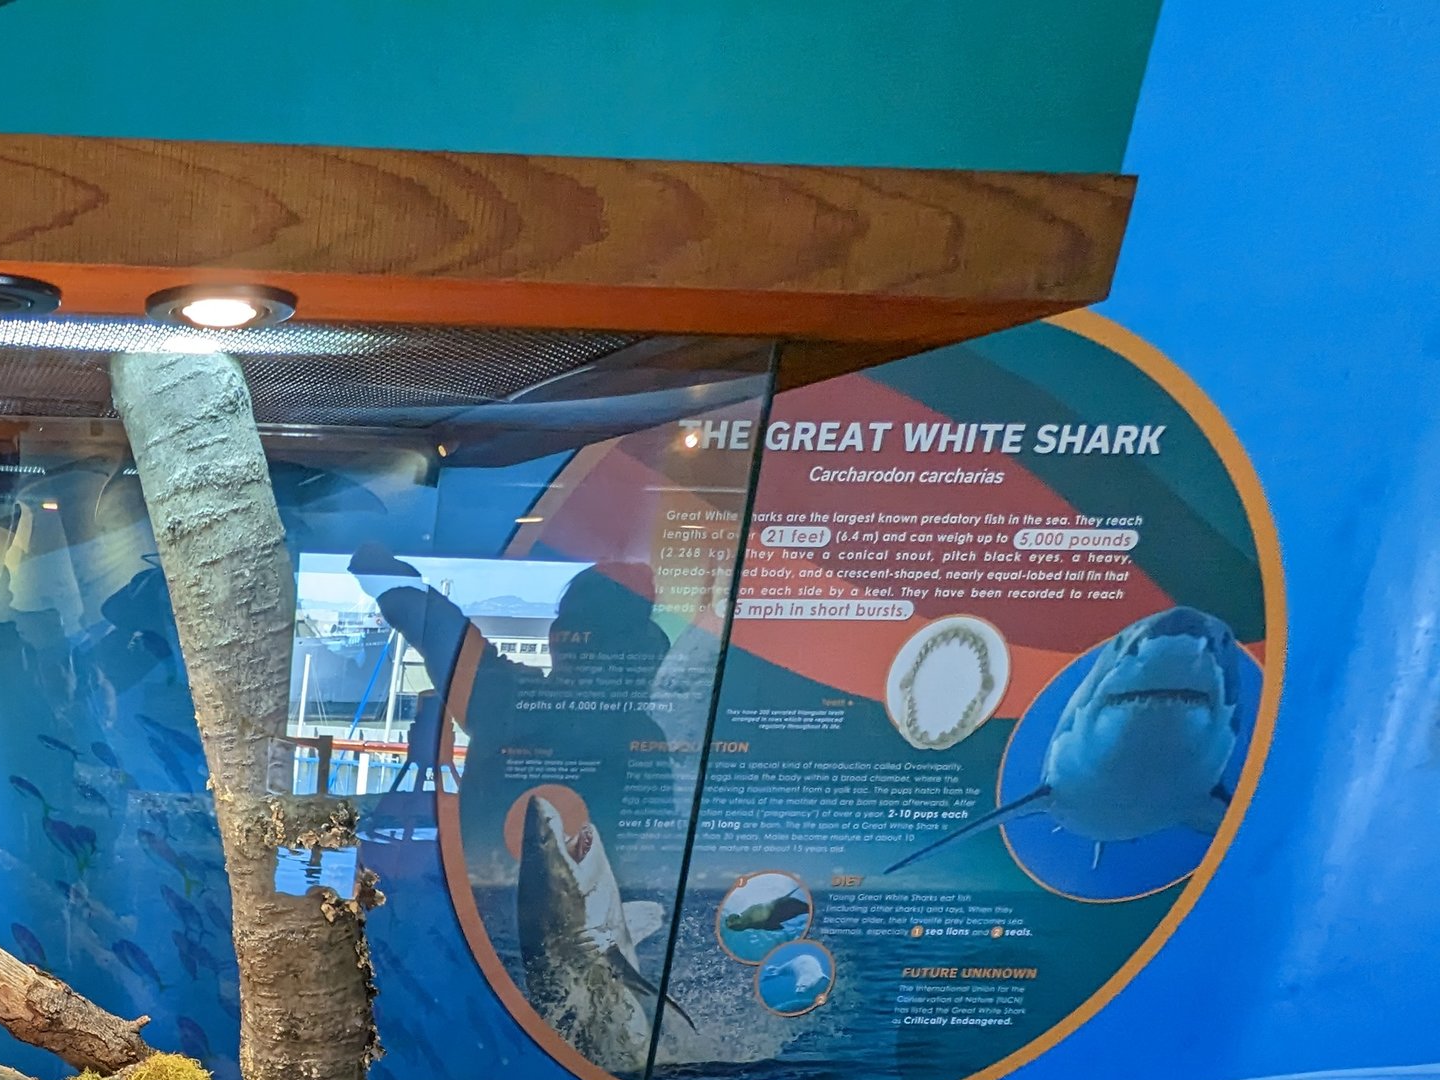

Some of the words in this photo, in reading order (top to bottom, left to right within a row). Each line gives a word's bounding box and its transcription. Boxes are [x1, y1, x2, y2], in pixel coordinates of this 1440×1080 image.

[678, 419, 752, 450] THE
[765, 420, 893, 452] GREAT
[903, 422, 1026, 453] WHITE
[1032, 423, 1167, 455] SHARK
[809, 465, 915, 482] Carcharodon
[918, 467, 1004, 483] carcharias
[666, 511, 701, 521] Great
[786, 514, 806, 522] are
[809, 512, 829, 522] the
[832, 512, 874, 525] largest
[877, 512, 917, 523] known
[920, 513, 981, 526] predatory
[984, 513, 1004, 524] fish
[1023, 514, 1042, 524] the
[1045, 516, 1070, 525] sea.
[1075, 514, 1103, 527] They
[1105, 515, 1142, 525] reach
[766, 529, 783, 542] 21
[791, 529, 828, 545] feet
[835, 530, 859, 543] (6.4
[882, 531, 906, 541] and
[909, 533, 933, 542] can
[937, 532, 973, 544] weigh
[976, 534, 992, 544] up
[995, 532, 1008, 542] to
[1019, 532, 1063, 546] 5,000
[1068, 532, 1130, 548] pounds
[781, 548, 814, 559] have
[838, 549, 888, 559] conical
[895, 550, 933, 561] snout,
[942, 550, 975, 562] pitch
[983, 551, 1021, 561] black
[1028, 553, 1062, 563] eyes,
[1087, 552, 1131, 564] heavy,
[748, 603, 783, 618] mph
[809, 603, 849, 615] short
[855, 603, 907, 616] bursts.
[630, 741, 750, 753] REPRODUTION
[888, 809, 911, 819] 2-10
[913, 810, 938, 821] pups
[941, 810, 968, 819] each
[618, 820, 642, 828] over
[717, 819, 741, 830] long
[831, 875, 864, 887] DIET
[925, 928, 944, 937] sea
[946, 927, 970, 937] lions
[1004, 927, 1033, 937] seals.
[902, 967, 958, 978] FUTURE
[961, 967, 1036, 978] UNKNOWN
[903, 1015, 948, 1026] Critically
[950, 1015, 1013, 1027] Endangered.
